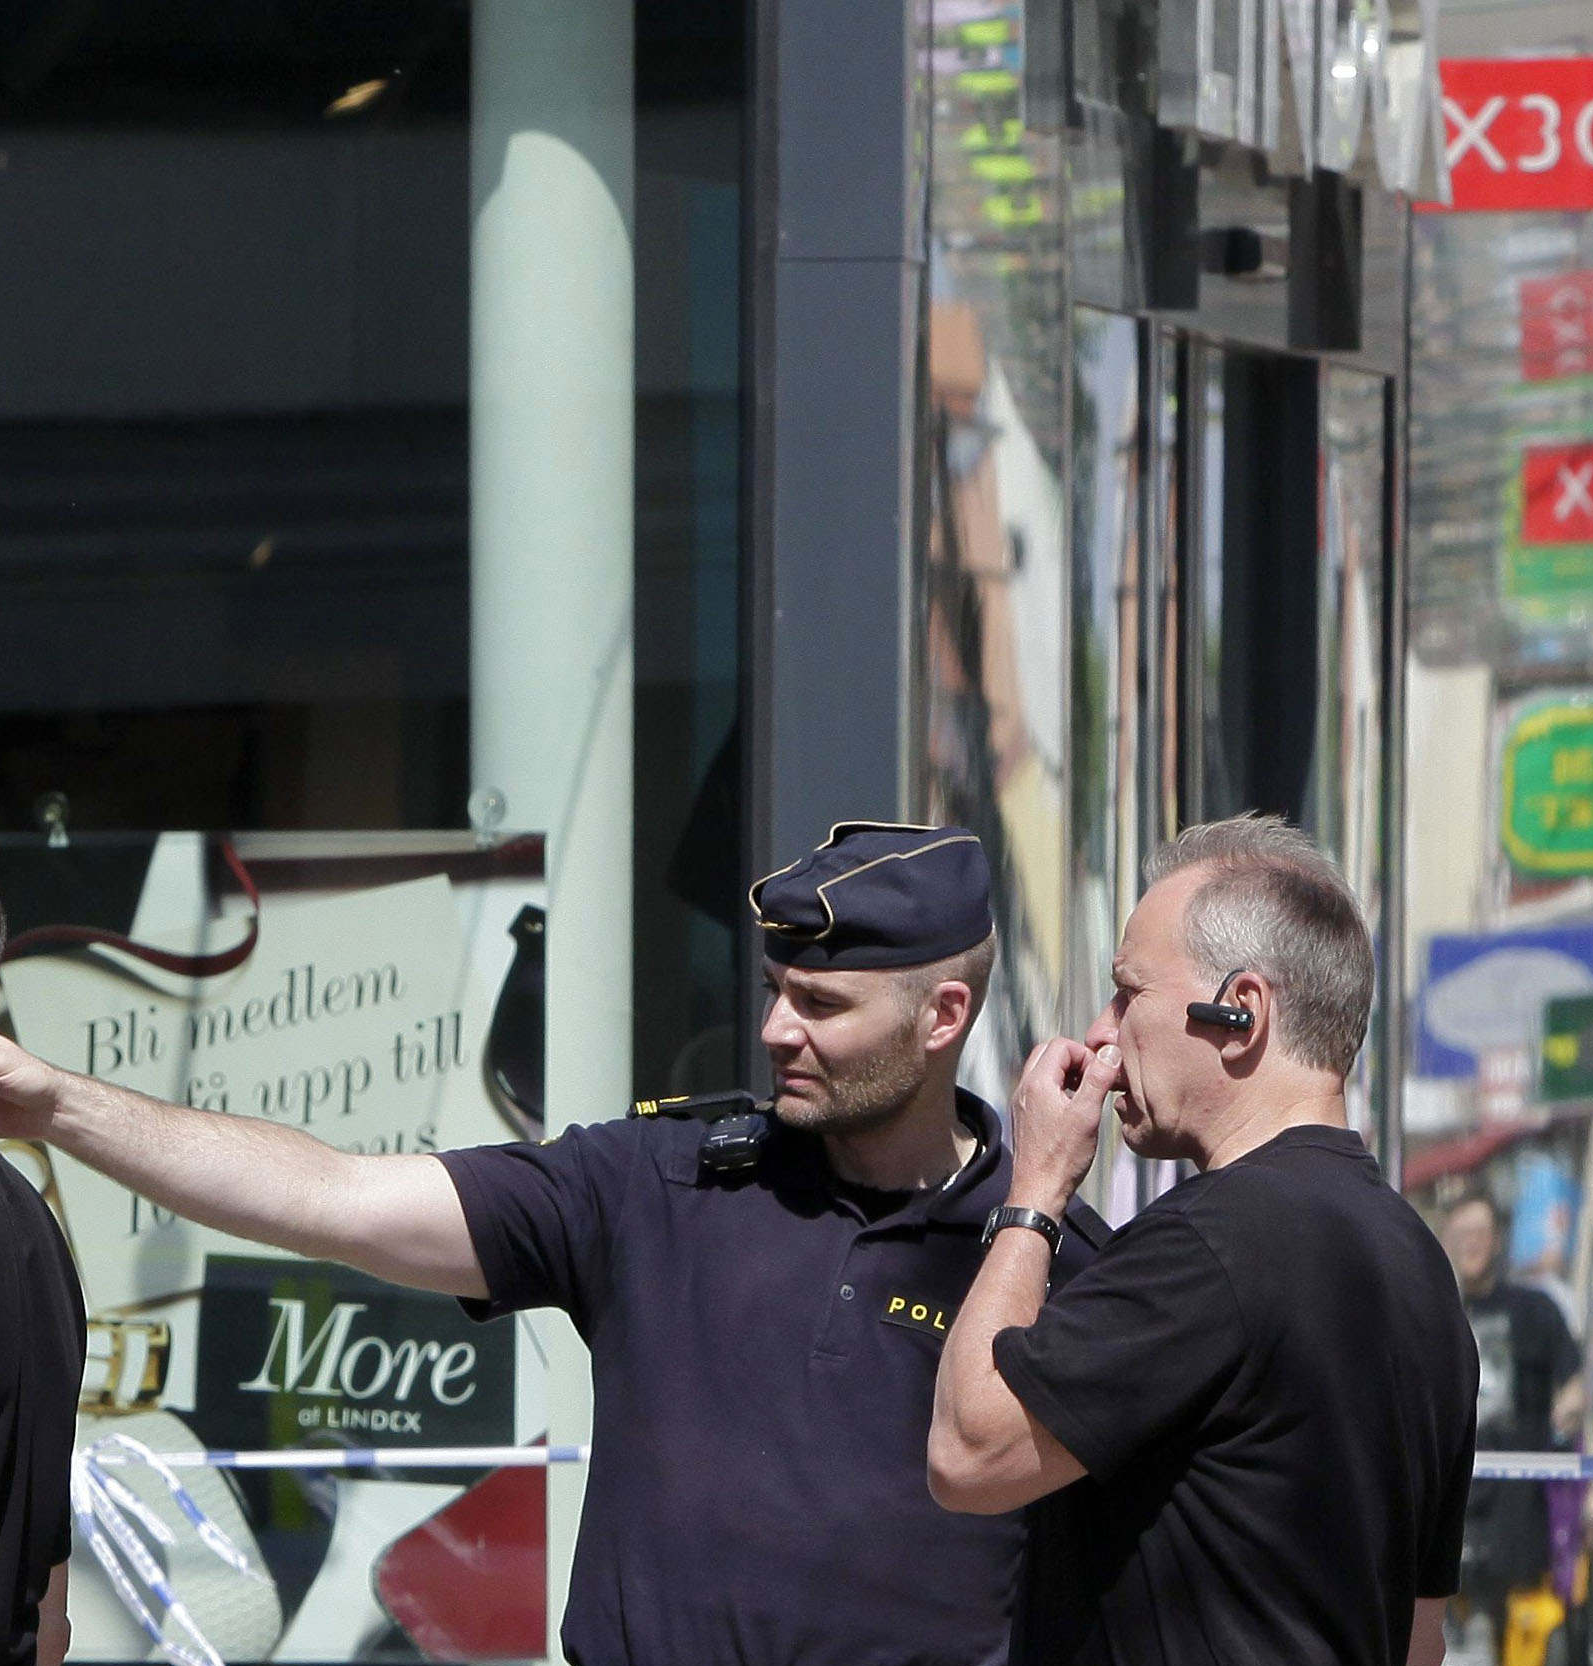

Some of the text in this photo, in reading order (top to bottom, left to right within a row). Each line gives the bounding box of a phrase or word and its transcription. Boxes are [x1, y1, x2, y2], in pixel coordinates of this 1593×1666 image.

[85, 963, 403, 1077] Bli medlem
[256, 1056, 373, 1125] upp
[393, 1010, 467, 1083] till
[239, 1297, 477, 1406] More
[888, 1297, 947, 1332] POL
[327, 1405, 423, 1434] LINDEX
